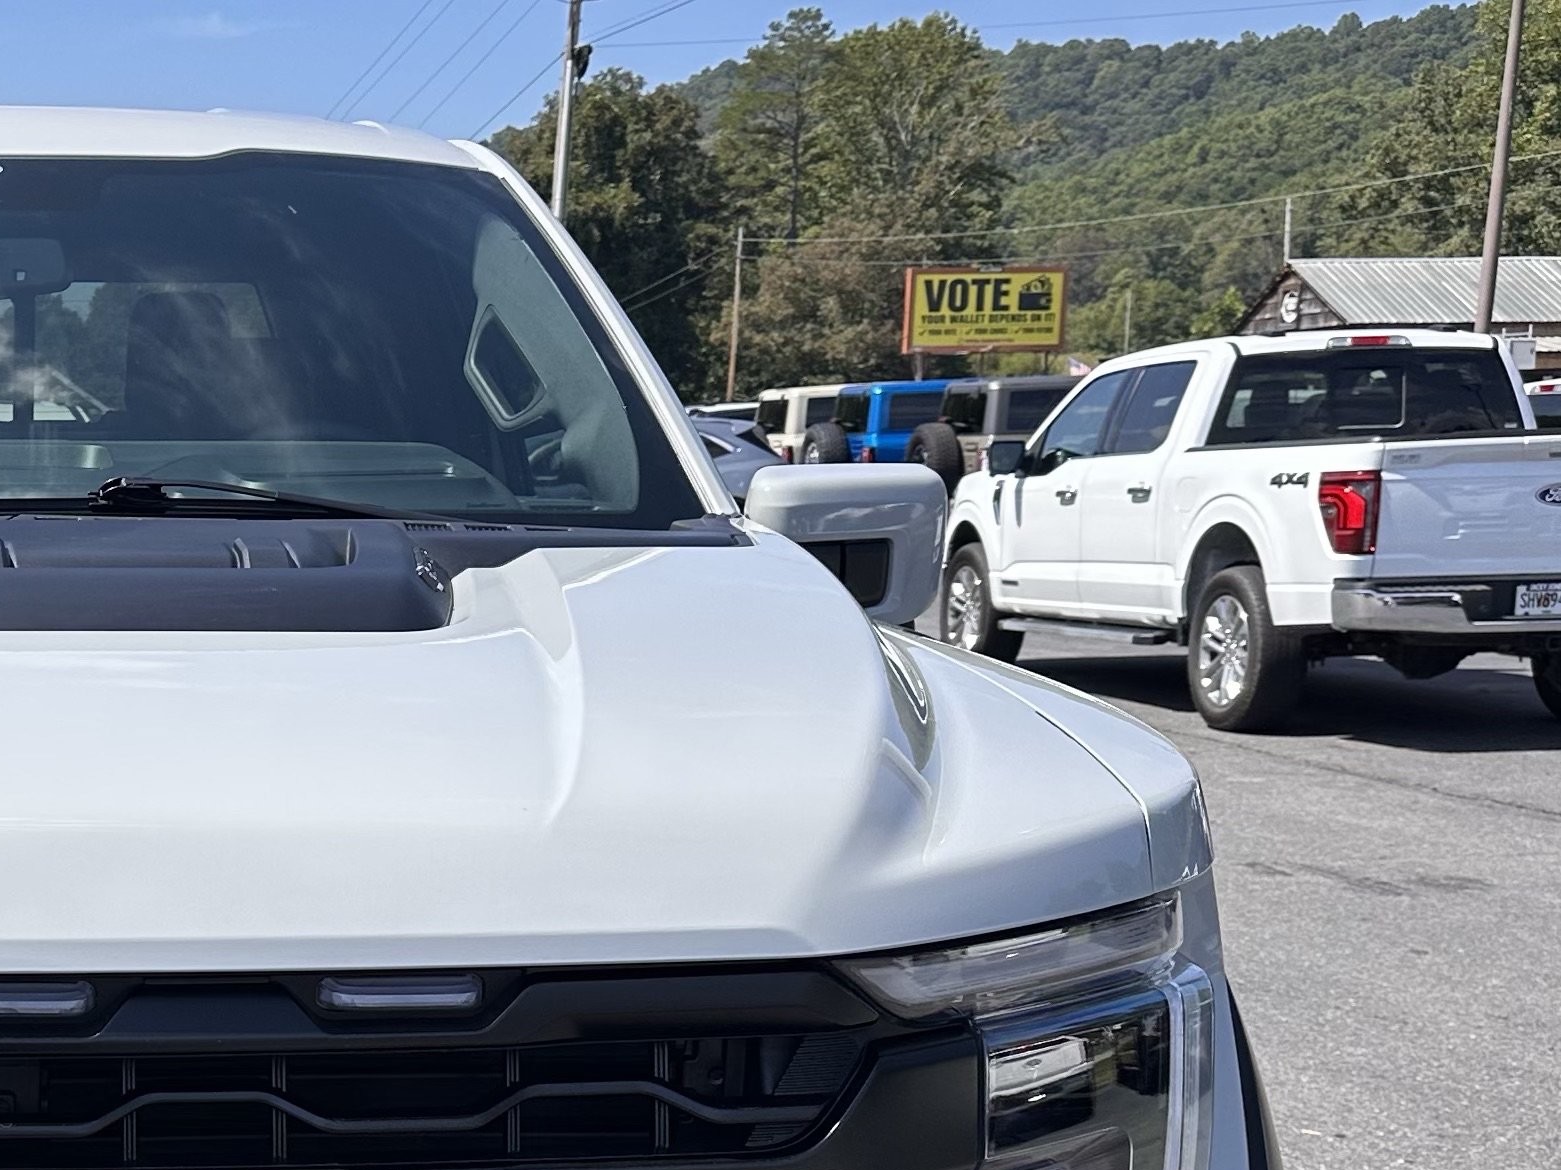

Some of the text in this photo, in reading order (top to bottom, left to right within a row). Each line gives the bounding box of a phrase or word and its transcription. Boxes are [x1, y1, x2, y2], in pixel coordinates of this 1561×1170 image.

[924, 278, 1011, 312] VOTE
[921, 314, 946, 324] YOUR
[950, 313, 986, 324] WALLET
[989, 312, 1027, 323] DEPENDS
[1030, 312, 1042, 322] ON
